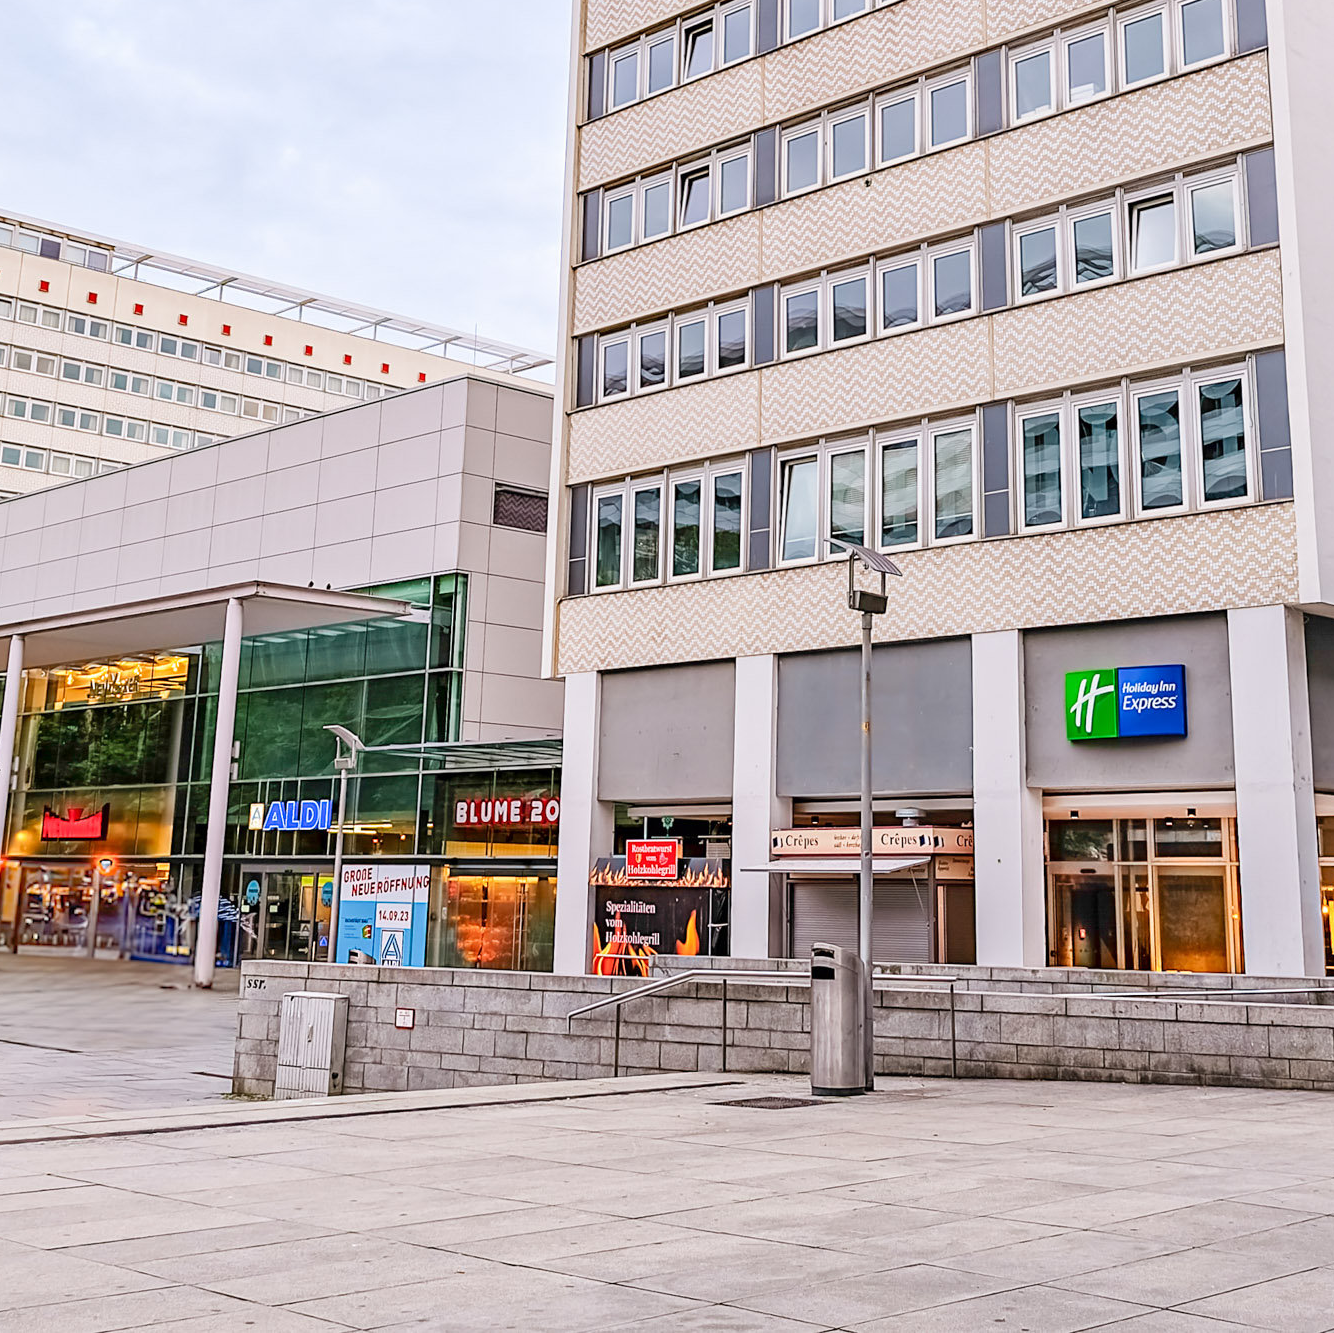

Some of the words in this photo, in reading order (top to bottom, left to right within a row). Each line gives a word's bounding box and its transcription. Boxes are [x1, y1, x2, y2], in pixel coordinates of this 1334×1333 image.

[1122, 681, 1159, 695] Holiday
[1159, 680, 1176, 692] Inn
[1122, 694, 1178, 714] Express
[263, 799, 332, 831] ALDI
[456, 800, 521, 823] BLUME
[785, 834, 819, 849] Crêpes
[880, 833, 917, 848] Crêpes
[631, 844, 673, 853] Rostbratwurst
[627, 864, 676, 876] Holzkohlegrill
[606, 900, 656, 915] Spezialitäten
[378, 910, 409, 922] 14.09.23
[605, 918, 623, 928] vom
[605, 931, 660, 947] Holzkohlegrill
